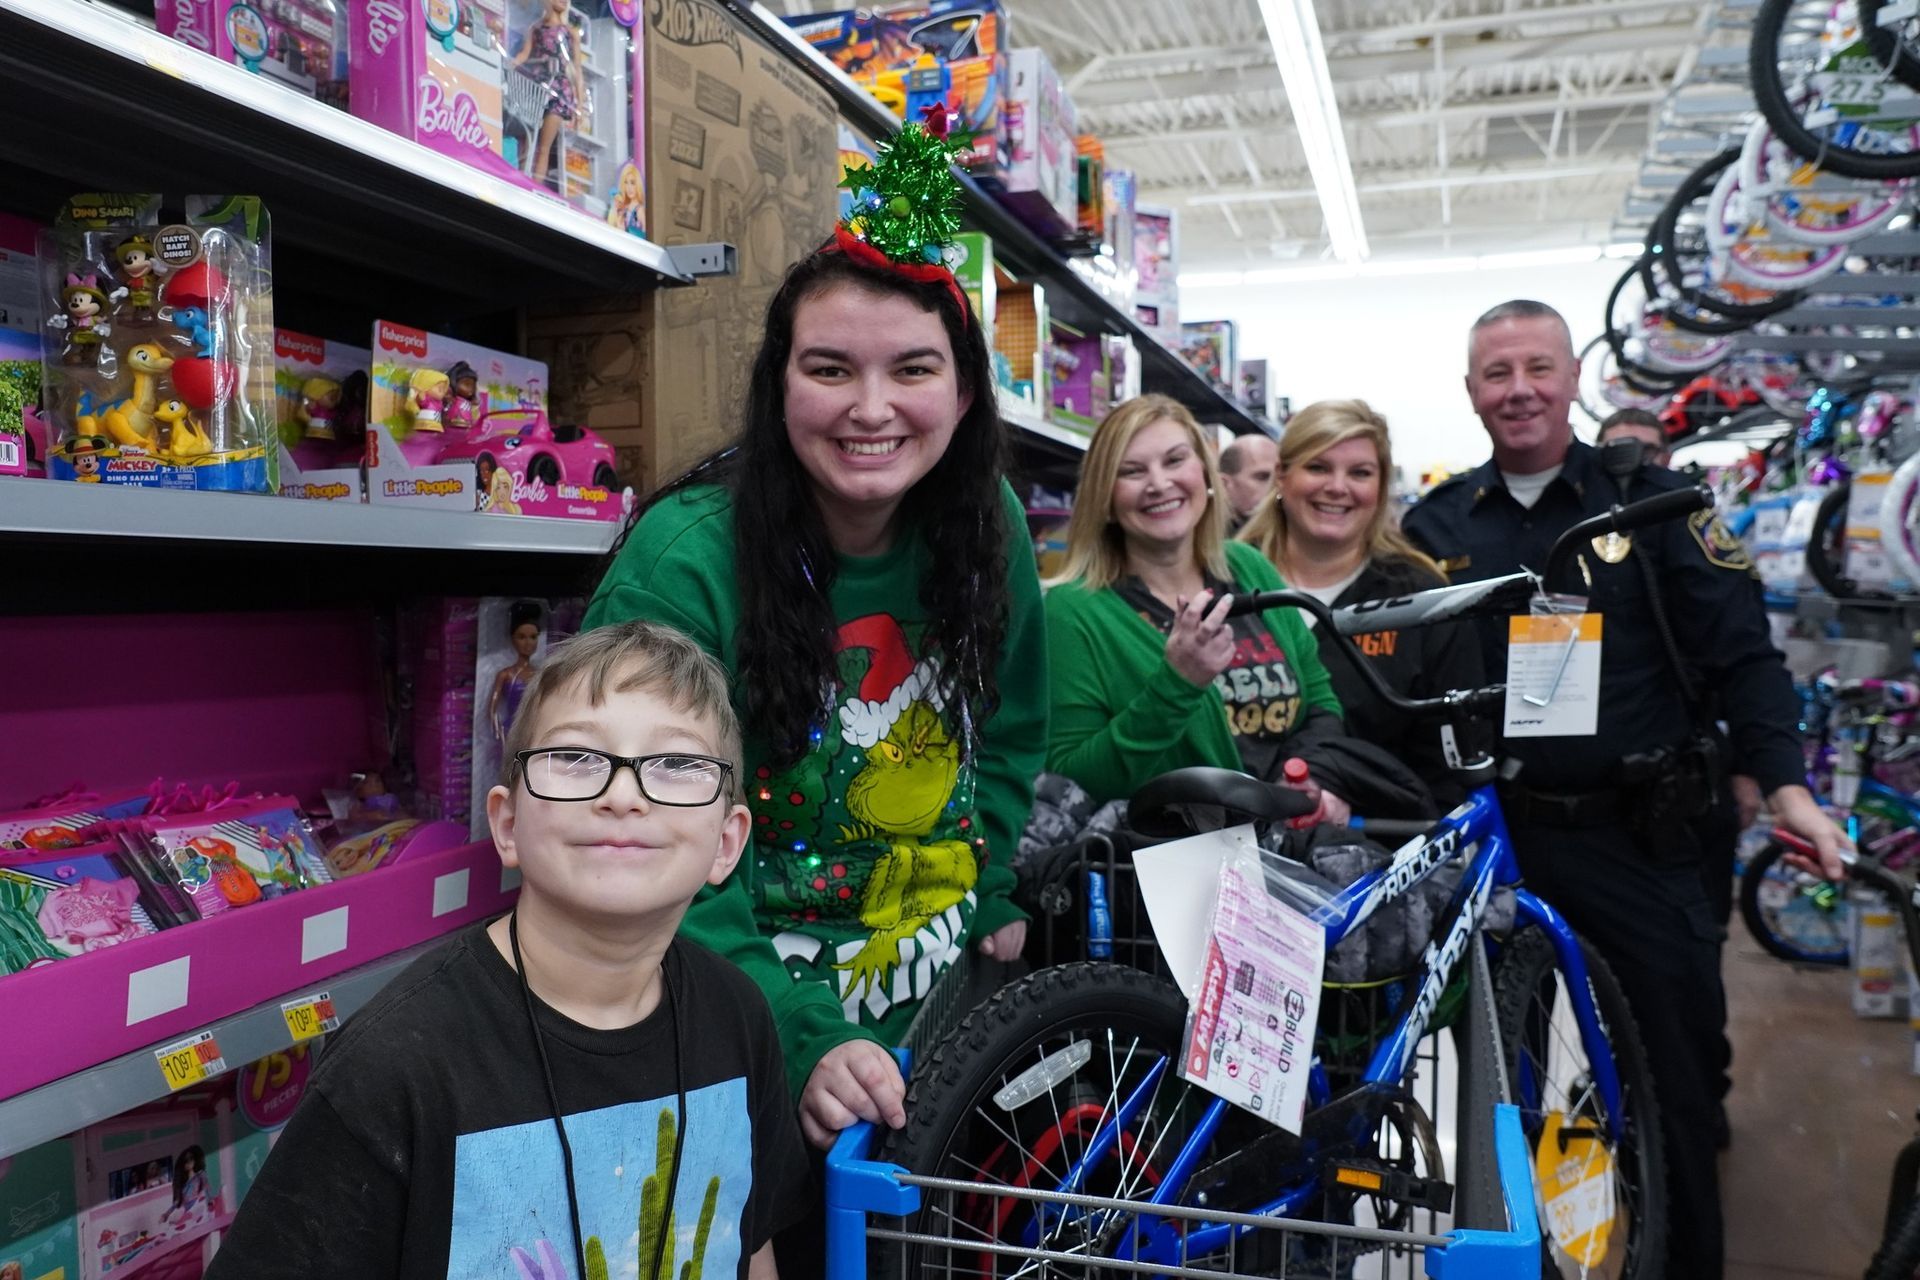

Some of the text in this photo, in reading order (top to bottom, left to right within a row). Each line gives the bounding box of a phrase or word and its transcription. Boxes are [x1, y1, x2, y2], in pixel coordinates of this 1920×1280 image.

[418, 75, 492, 149] Barbie
[72, 206, 134, 218] DINO SAFARI
[162, 234, 190, 243] HATCH
[166, 242, 188, 251] BABY
[163, 249, 192, 259] DINOS!
[381, 326, 426, 349] fisher-price
[106, 459, 157, 473] MICKEY
[510, 471, 549, 503] Barbie
[1386, 827, 1459, 904] ROCK IT
[1278, 1019, 1299, 1074] BUILD
